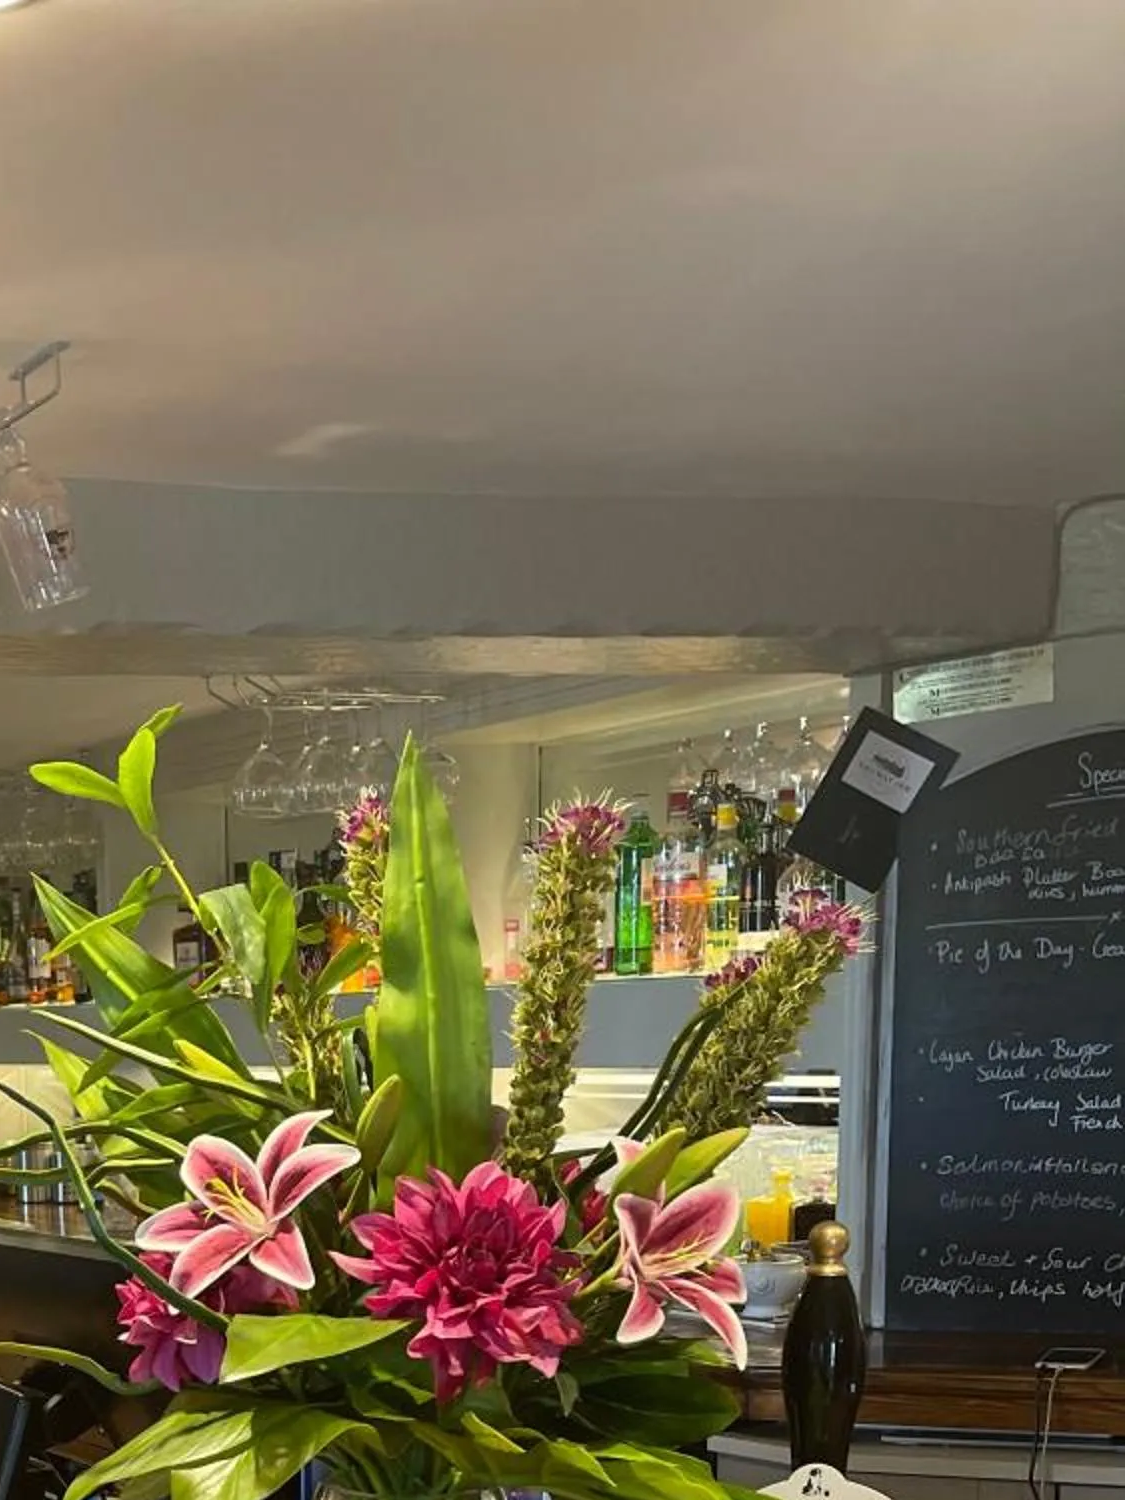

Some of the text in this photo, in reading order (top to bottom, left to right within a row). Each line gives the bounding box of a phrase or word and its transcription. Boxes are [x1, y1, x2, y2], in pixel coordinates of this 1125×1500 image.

[976, 937, 990, 974] of
[1033, 937, 1074, 969] Day
[1050, 1037, 1114, 1064] Burger
[1076, 1091, 1122, 1112] Salad
